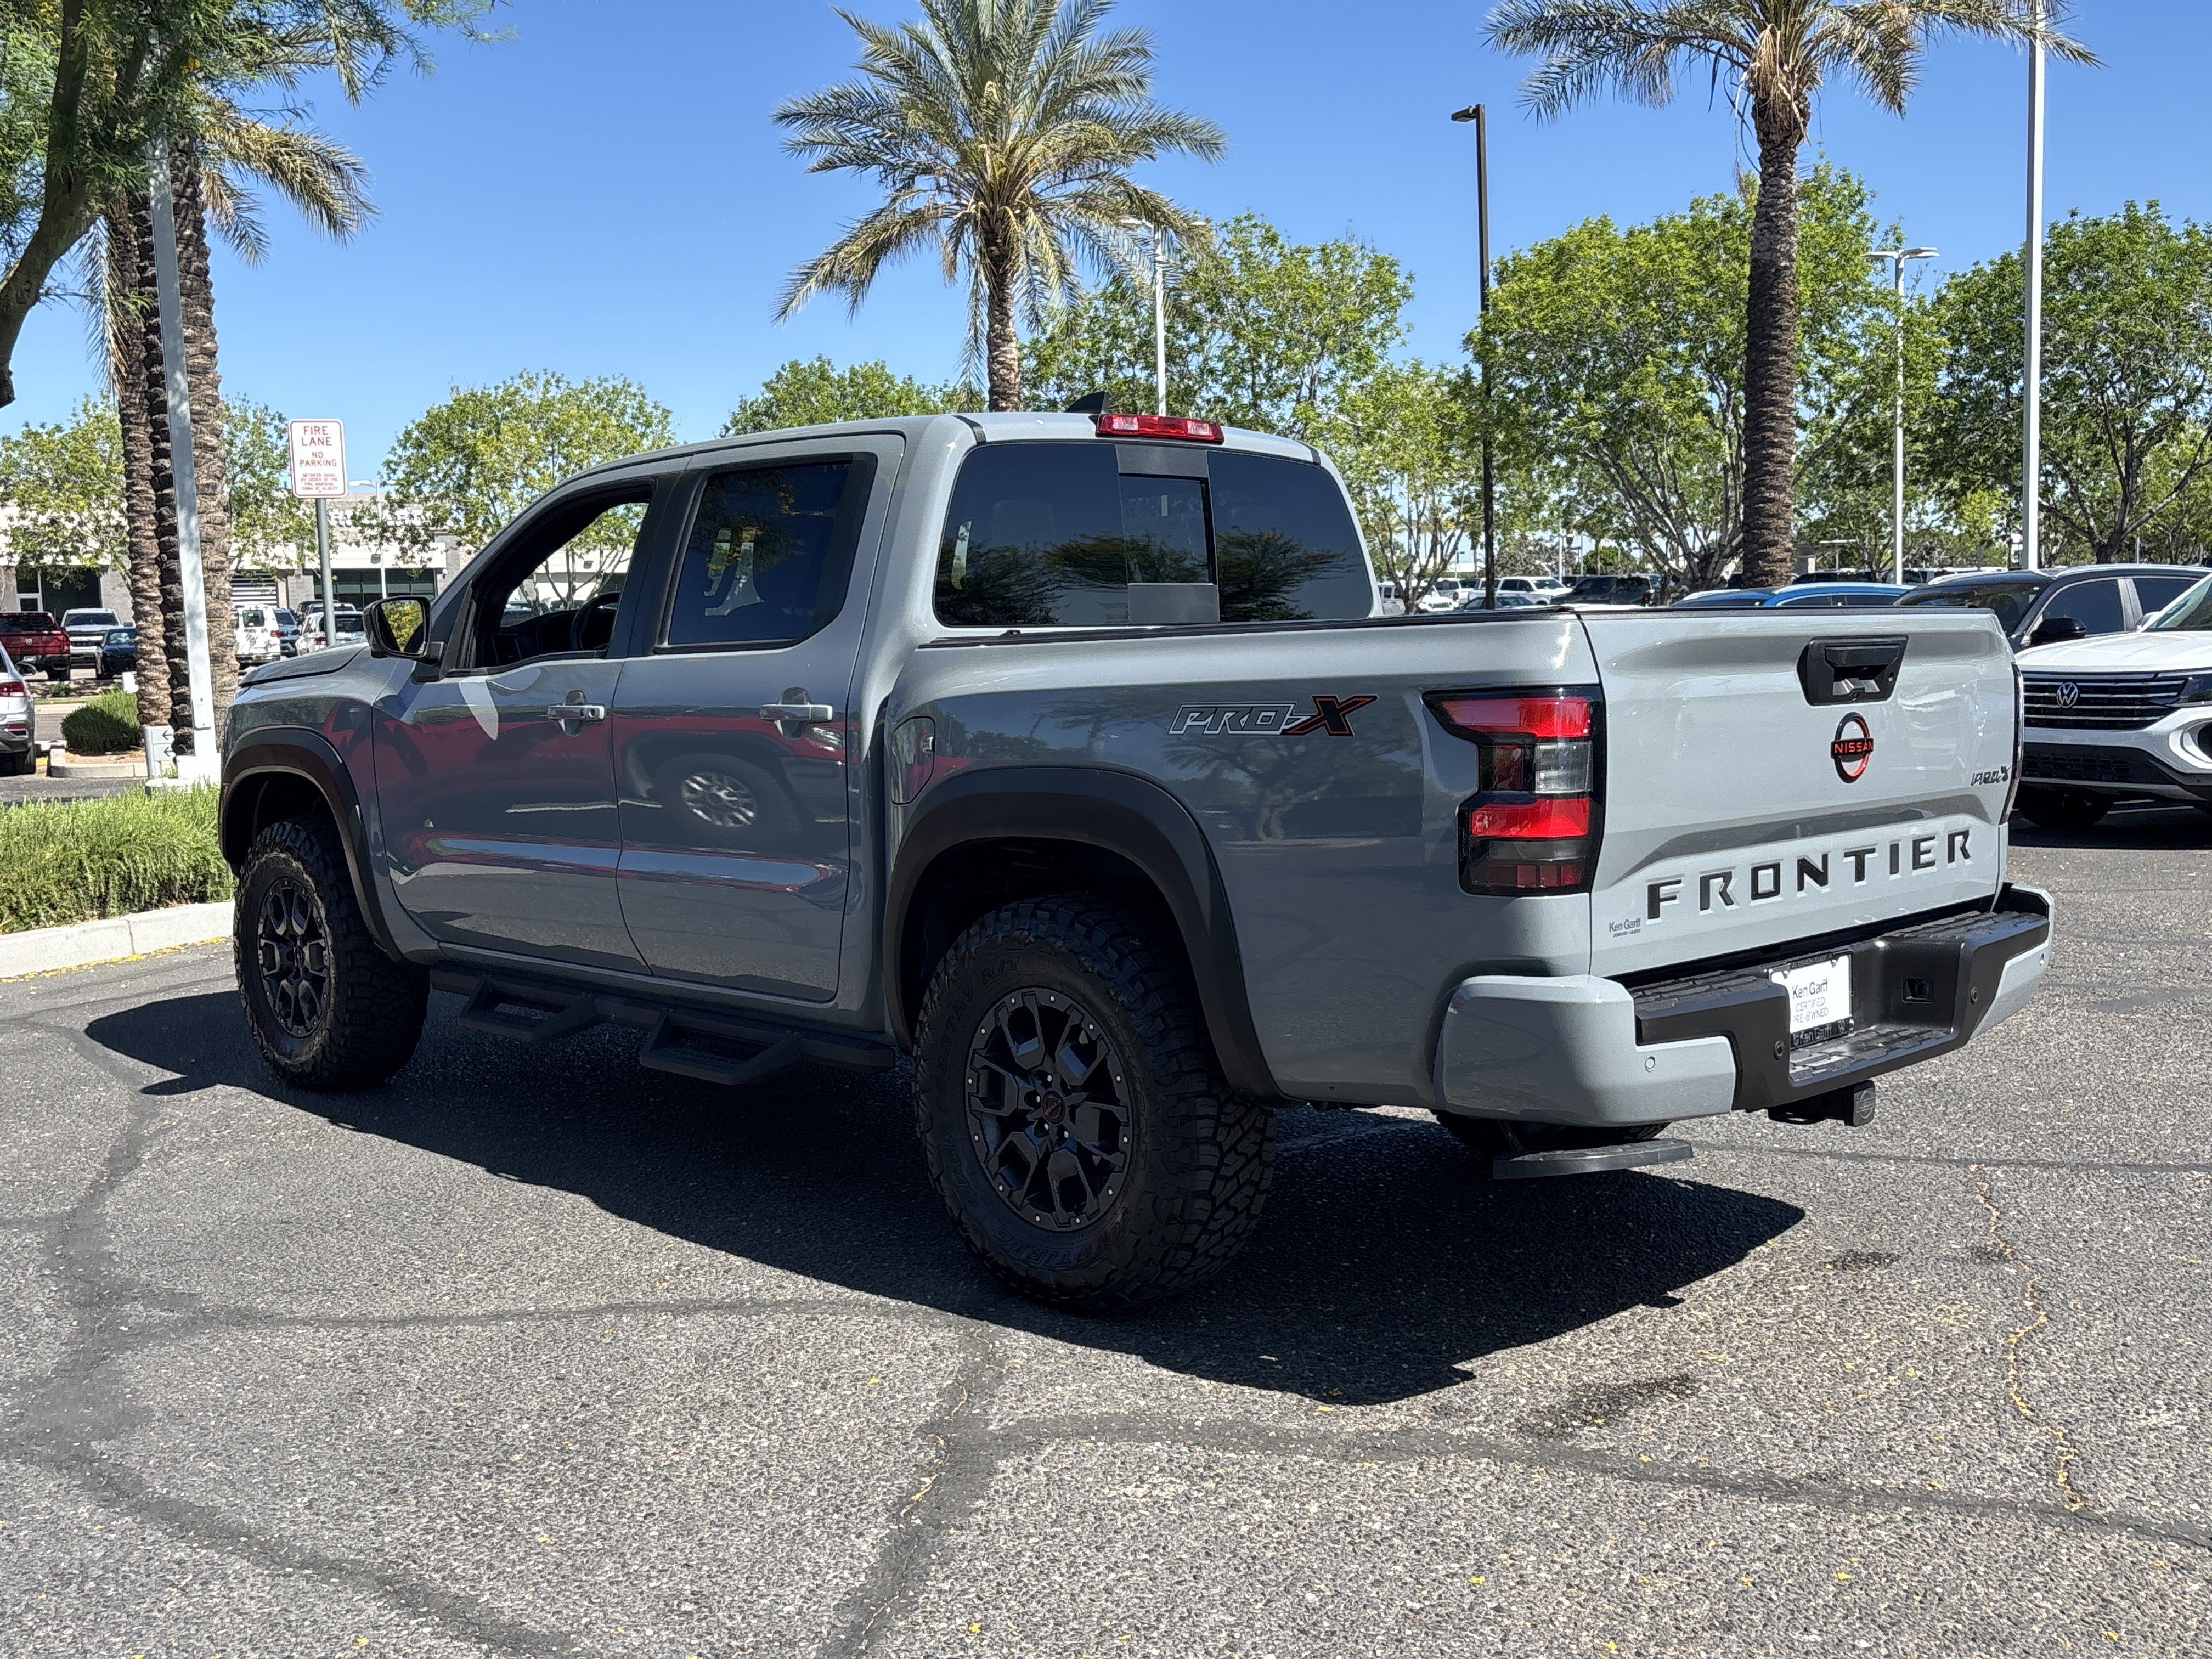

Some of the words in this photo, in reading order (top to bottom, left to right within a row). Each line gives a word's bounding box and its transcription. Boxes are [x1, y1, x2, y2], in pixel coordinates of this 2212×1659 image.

[303, 426, 328, 435] FIRE
[302, 437, 332, 446] LANE
[1835, 741, 1873, 753] NISSAN
[1647, 829, 1971, 920] FRONTIER
[1609, 922, 1623, 933] Ken
[1624, 917, 1641, 929] Garff
[1792, 985, 1808, 999] Ken
[1809, 978, 1828, 995] Garff
[1796, 997, 1825, 1012] CERTIFIED
